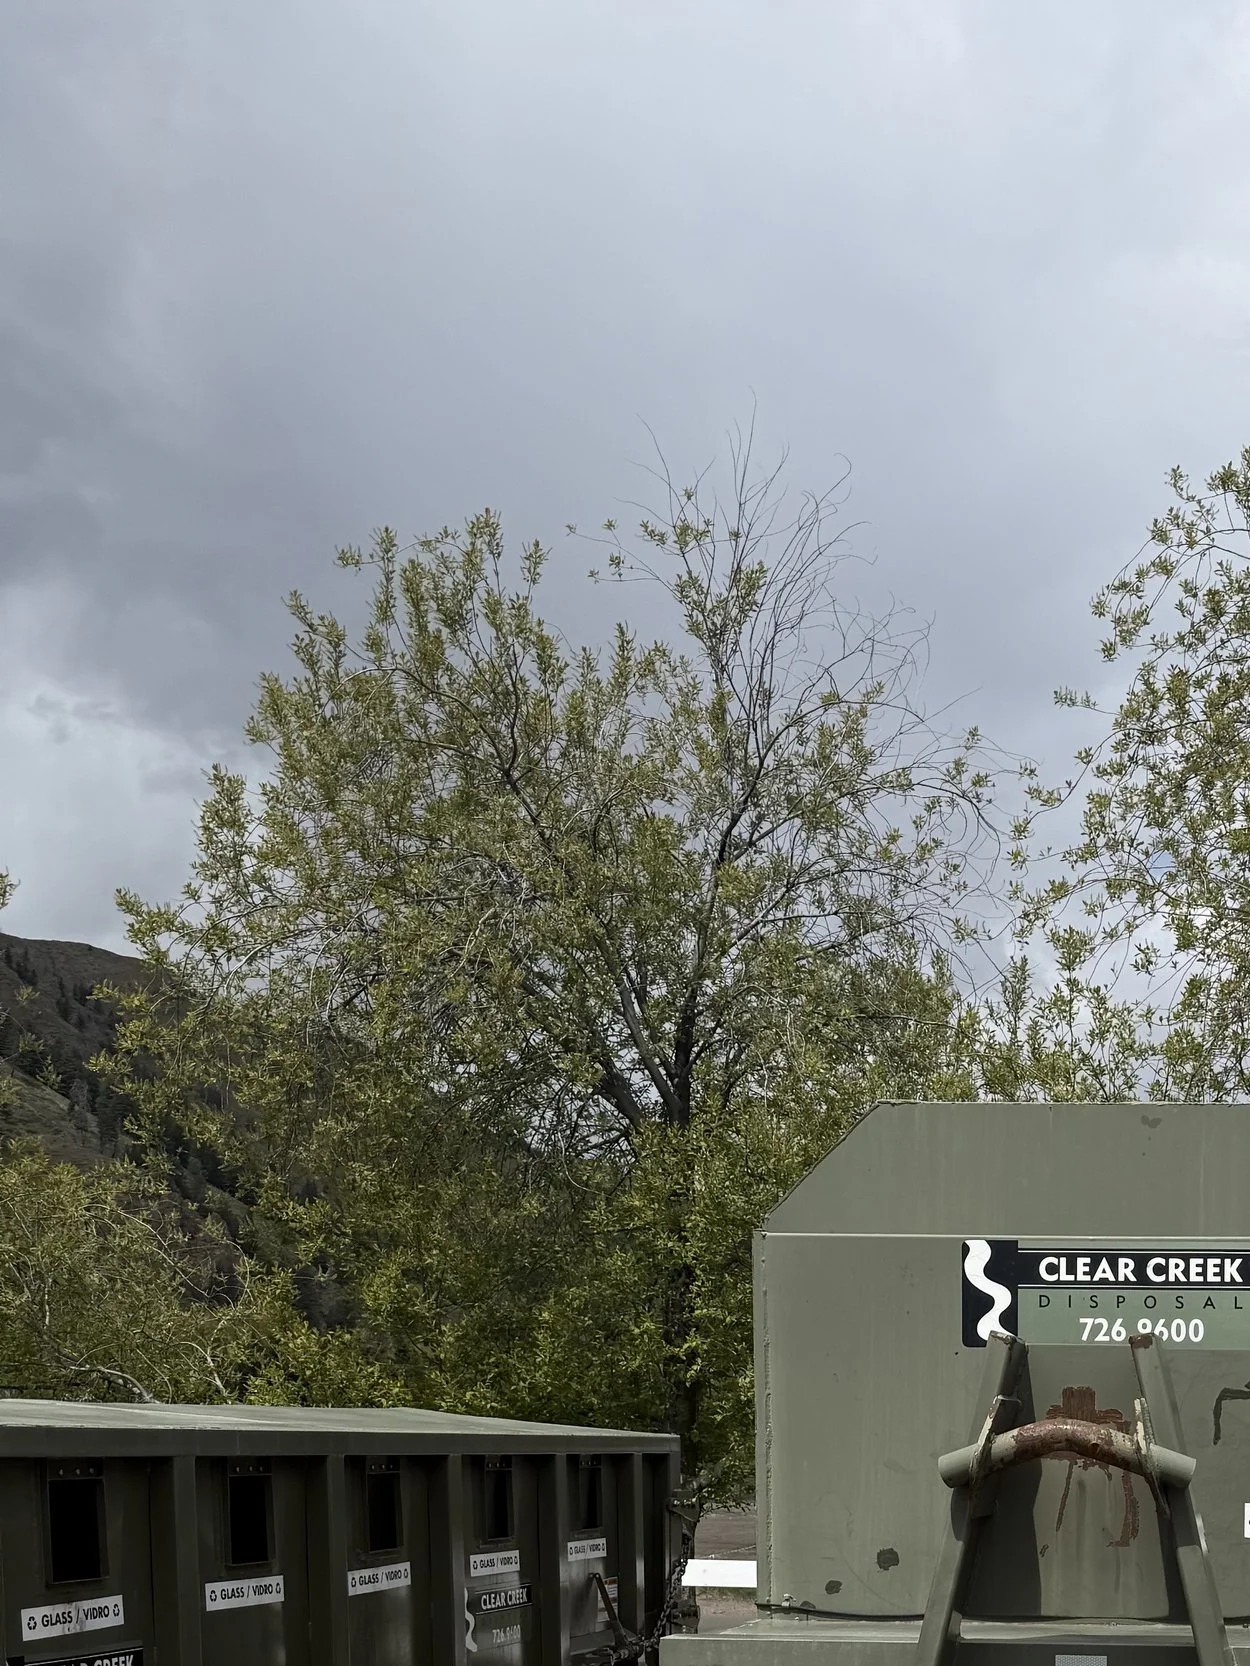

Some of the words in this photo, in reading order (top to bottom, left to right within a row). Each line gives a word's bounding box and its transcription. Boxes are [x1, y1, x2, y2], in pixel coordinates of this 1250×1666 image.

[1038, 1256, 1137, 1282] CLEAR
[1146, 1257, 1244, 1283] CREEK
[1039, 1294, 1243, 1310] DISPOSAL
[479, 1558, 496, 1569] GLASS
[358, 1574, 379, 1586] GLASS
[385, 1569, 402, 1581] VIDRO
[220, 1586, 245, 1600] GLASS
[252, 1583, 274, 1596] VIDRO
[481, 1592, 507, 1610] CLEAR
[507, 1588, 528, 1605] CREEK
[41, 1610, 73, 1628] GLASS
[82, 1605, 110, 1621] VIDRO
